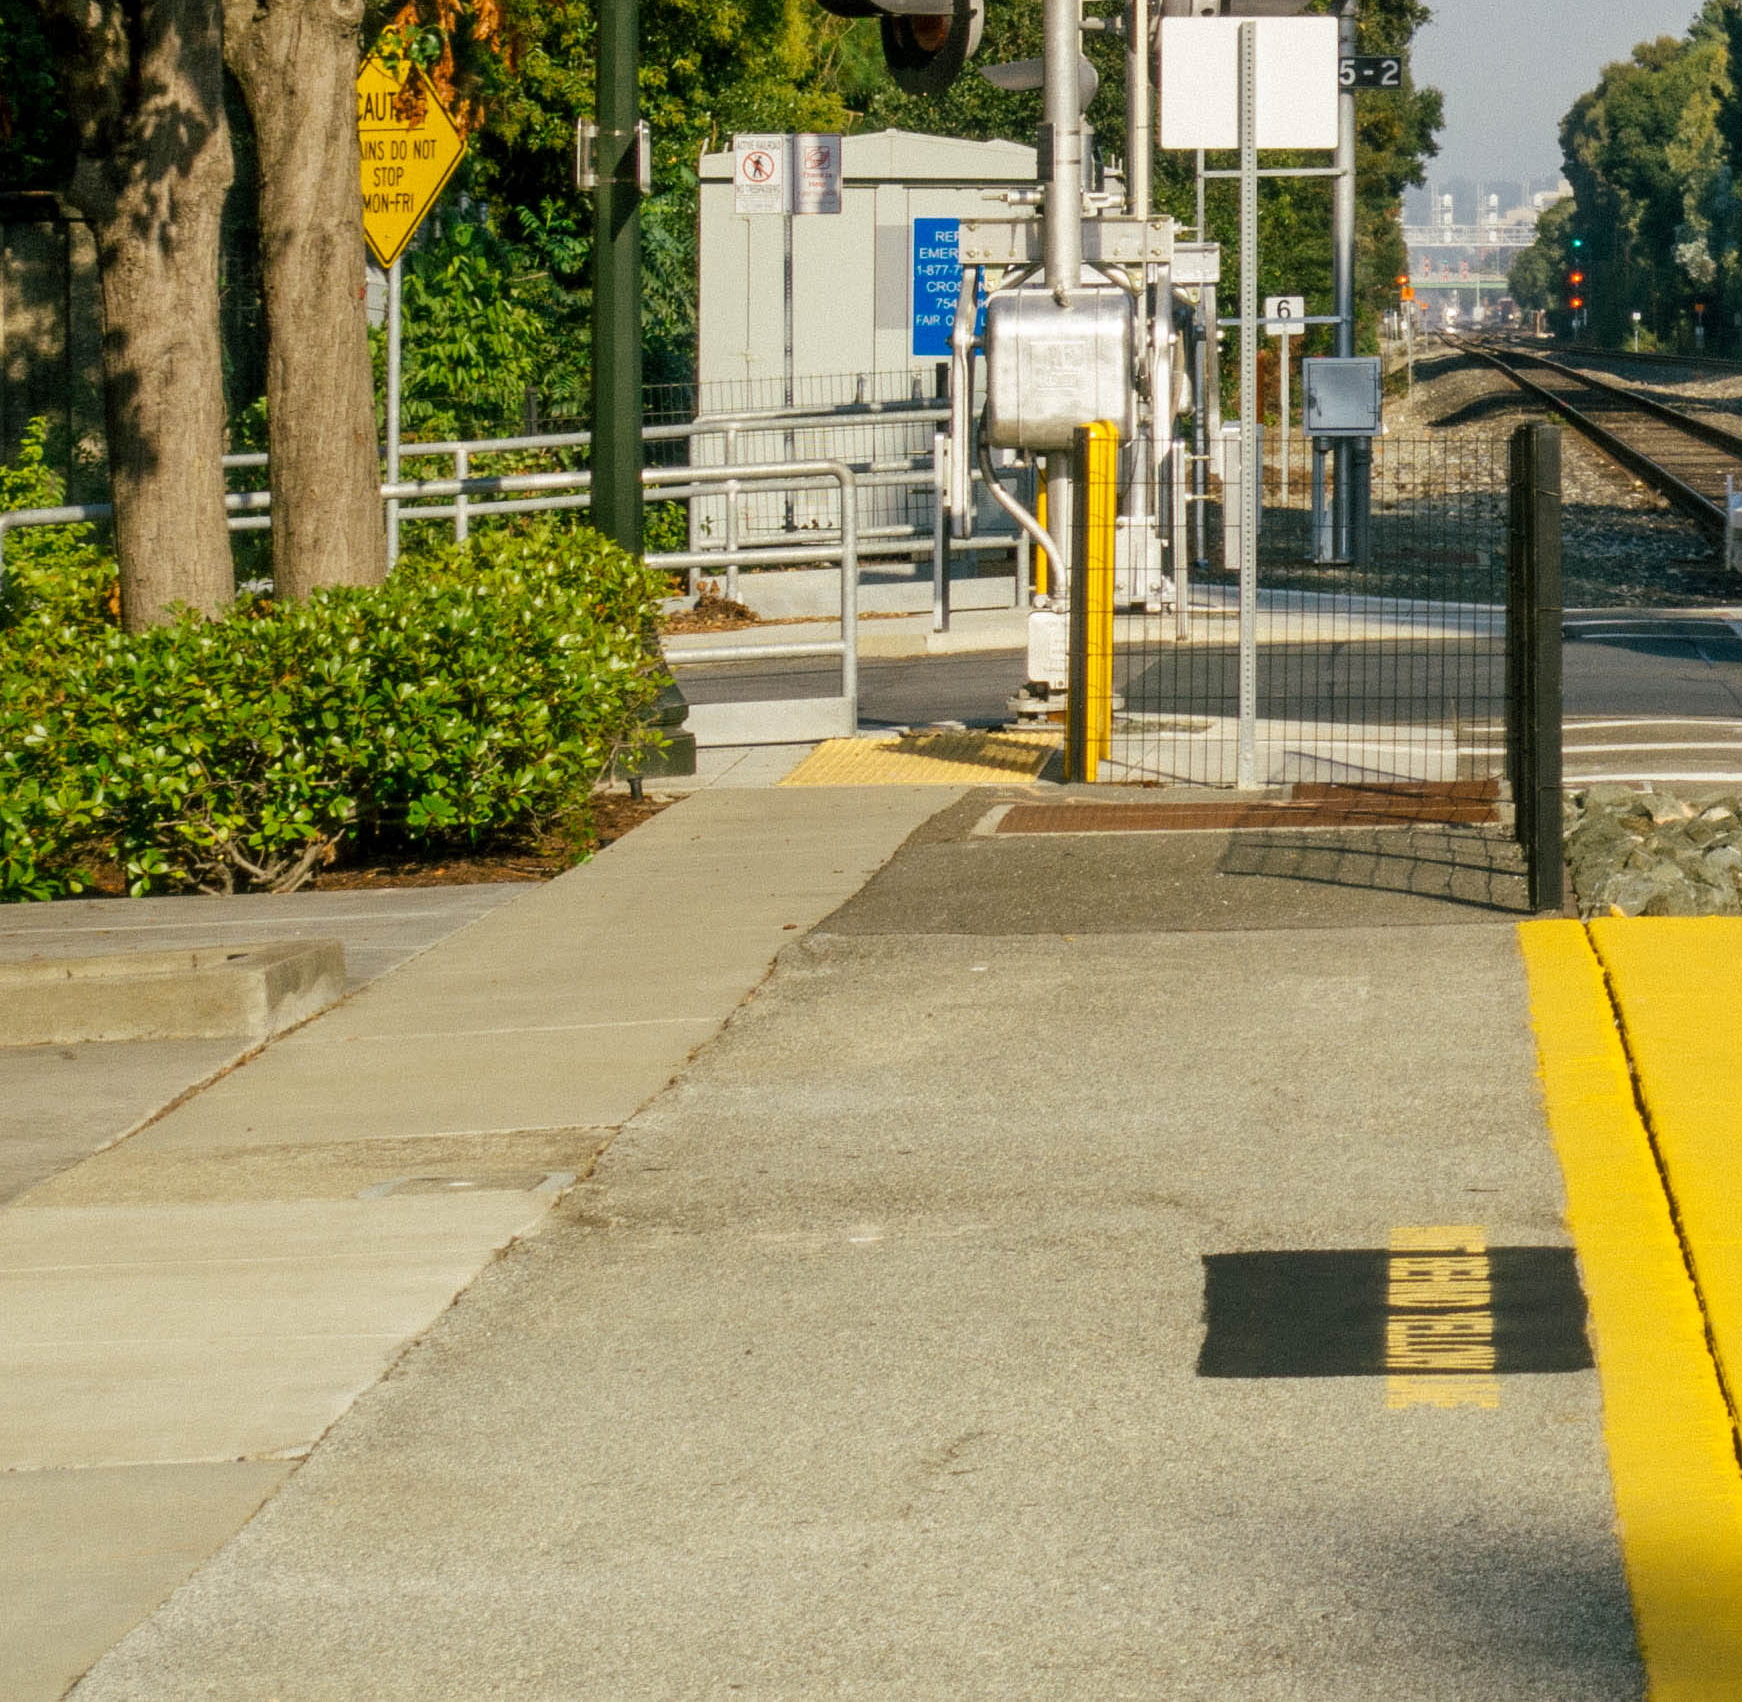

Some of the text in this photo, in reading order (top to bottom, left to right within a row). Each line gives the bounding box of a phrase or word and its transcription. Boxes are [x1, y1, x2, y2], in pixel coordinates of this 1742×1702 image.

[1339, 59, 1399, 86] 5-2
[357, 92, 397, 121] CAUT
[391, 140, 408, 160] DO
[413, 139, 437, 160] NOT
[373, 167, 404, 187] STOP
[363, 193, 414, 214] MON-FRI
[919, 247, 959, 259] EMER
[915, 314, 941, 327] FAIR
[1277, 299, 1291, 322] 6
[1385, 1310, 1496, 1370] YELLOW
